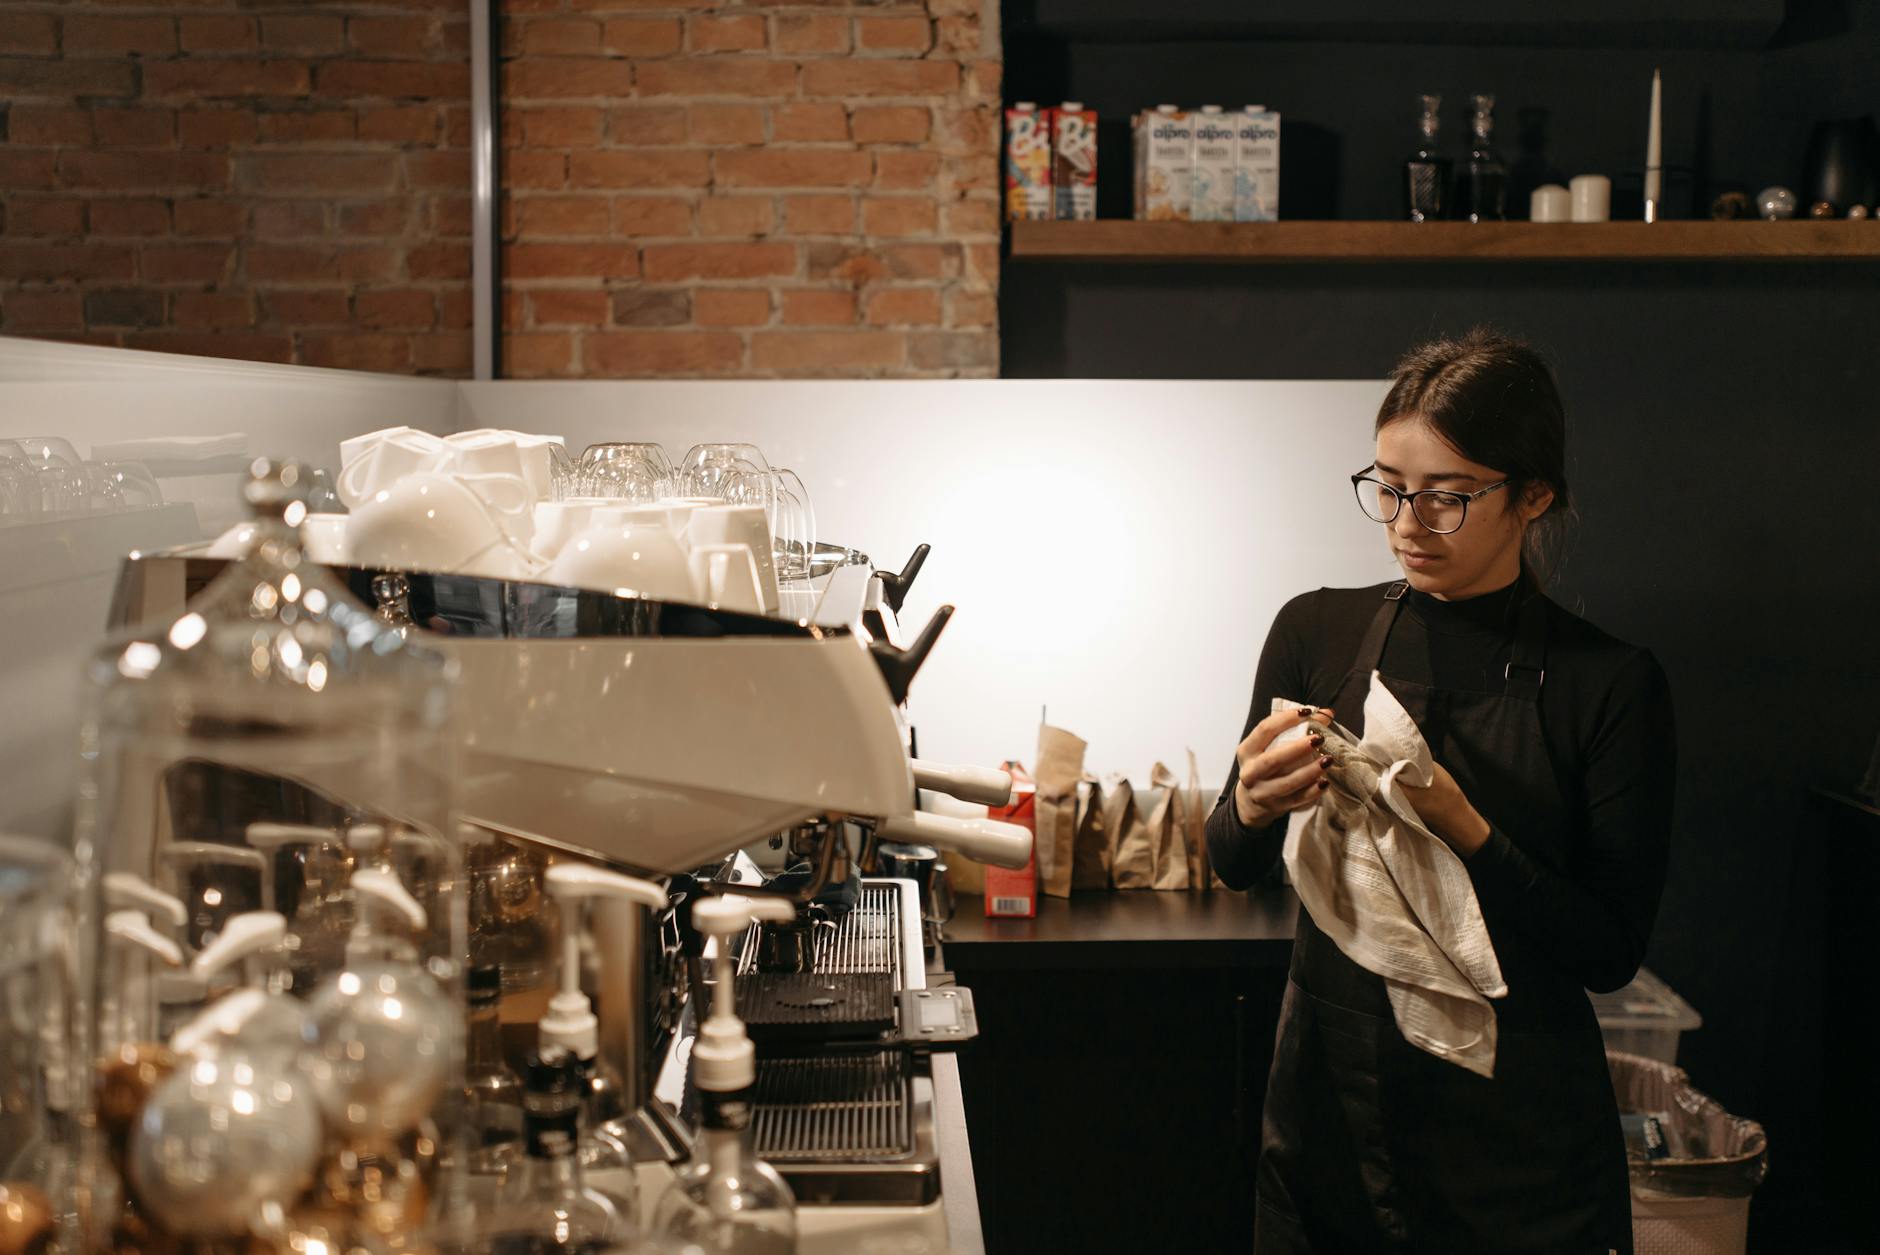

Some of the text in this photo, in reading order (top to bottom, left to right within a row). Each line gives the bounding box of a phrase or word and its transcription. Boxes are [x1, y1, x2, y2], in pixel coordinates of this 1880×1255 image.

[1153, 125, 1190, 142] alpro
[1196, 125, 1233, 142] alpro
[1239, 125, 1277, 142] alpro
